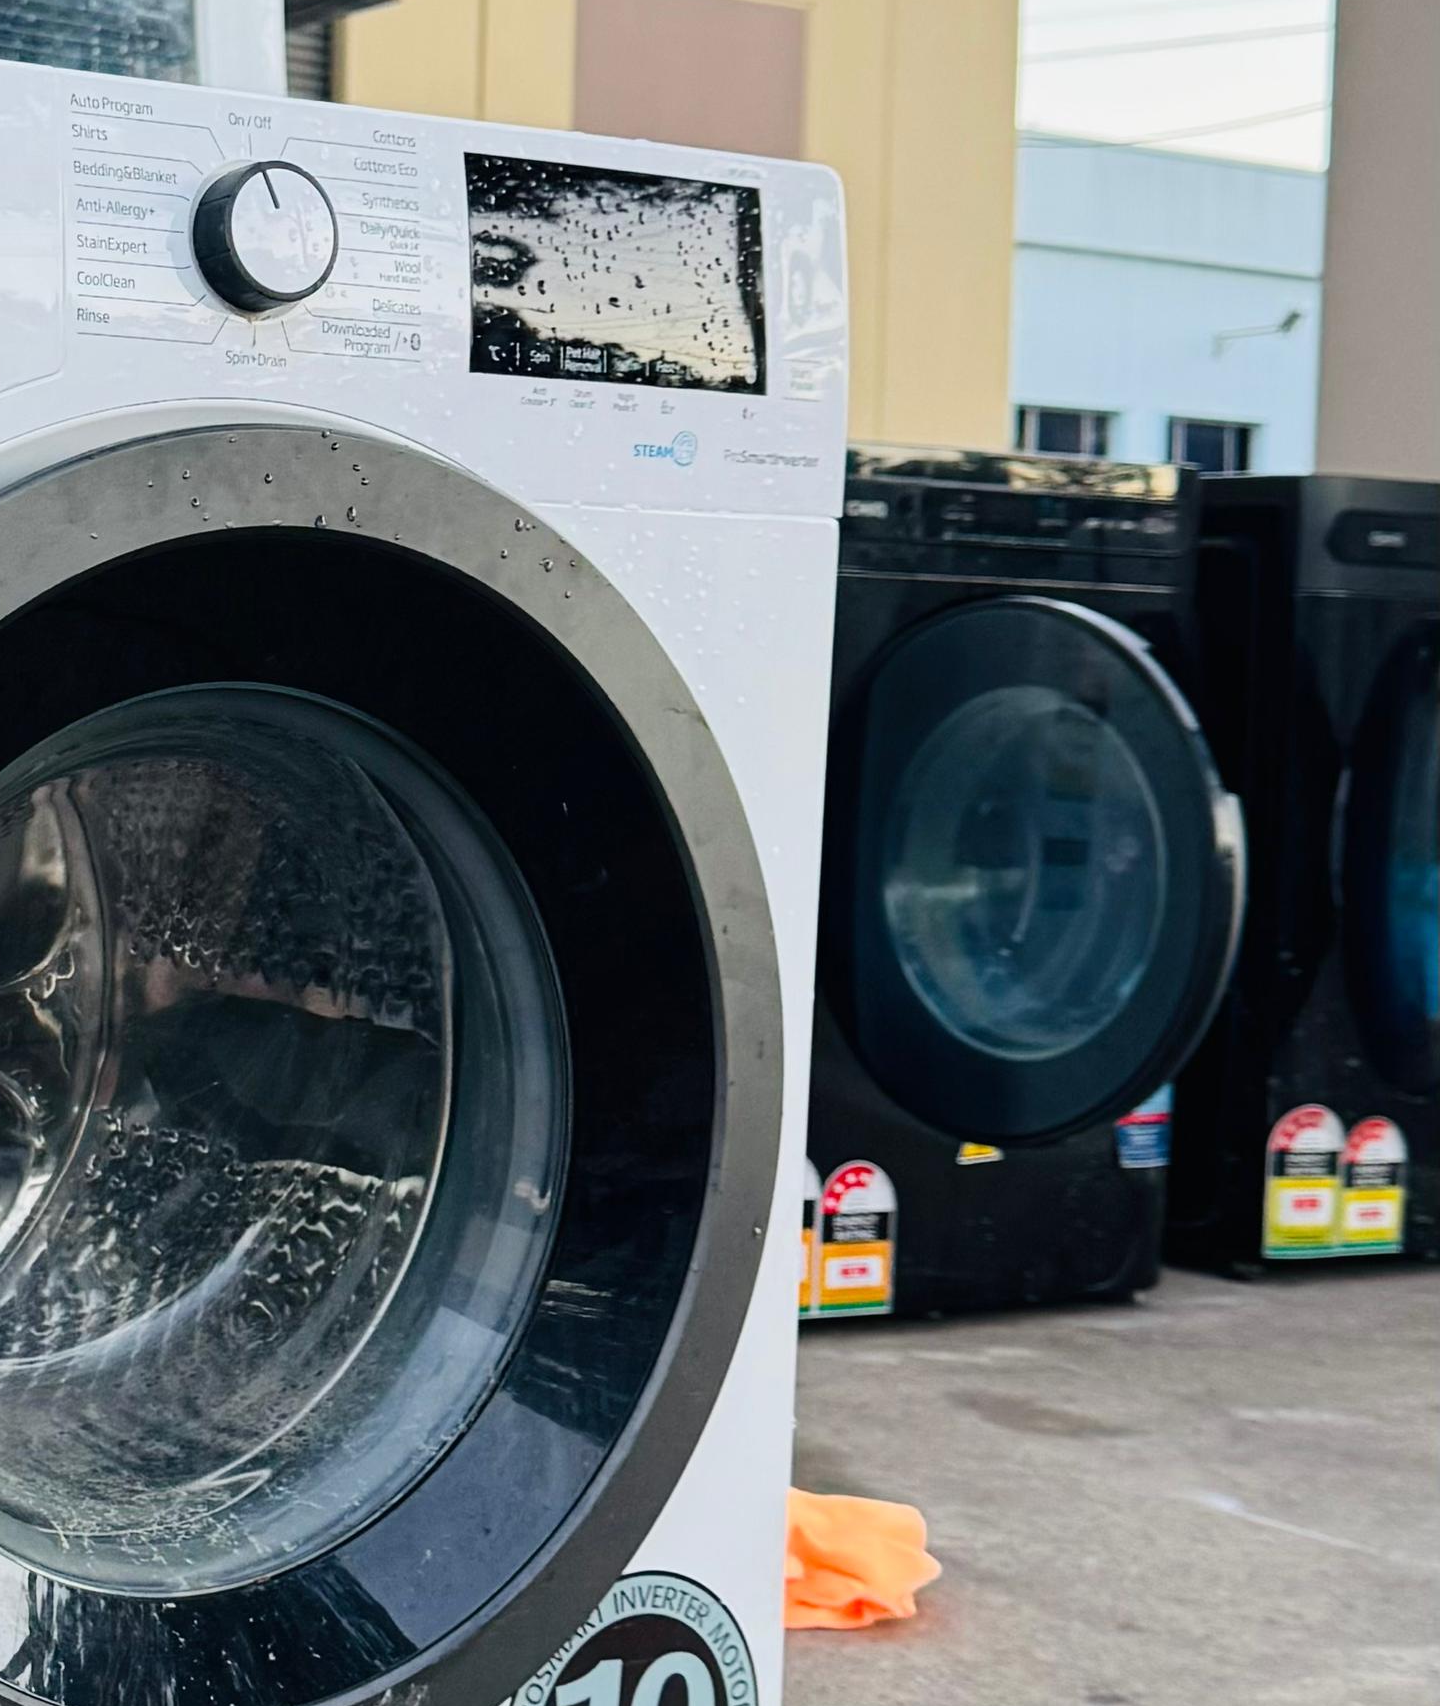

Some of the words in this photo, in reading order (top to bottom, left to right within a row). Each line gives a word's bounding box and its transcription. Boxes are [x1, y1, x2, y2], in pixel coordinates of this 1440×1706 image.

[70, 93, 100, 109] Auto
[102, 96, 154, 116] Program
[228, 112, 245, 126] On
[254, 115, 272, 130] Off
[71, 123, 108, 141] Shirts
[372, 130, 417, 148] Cottons
[73, 160, 178, 185] Bedding&Blanket
[353, 156, 397, 174] Cottons
[398, 162, 419, 177] Eco
[361, 192, 420, 212] Synthetics
[76, 234, 148, 255] StainExpert
[394, 260, 421, 274] Wool
[76, 271, 136, 289] CoolClean
[76, 307, 111, 324] Rinse
[372, 298, 422, 315] Delicates
[322, 320, 391, 339] Downloaded
[344, 338, 391, 357] Program
[633, 444, 675, 459] STEAM
[613, 1585, 710, 1628] INVERTER
